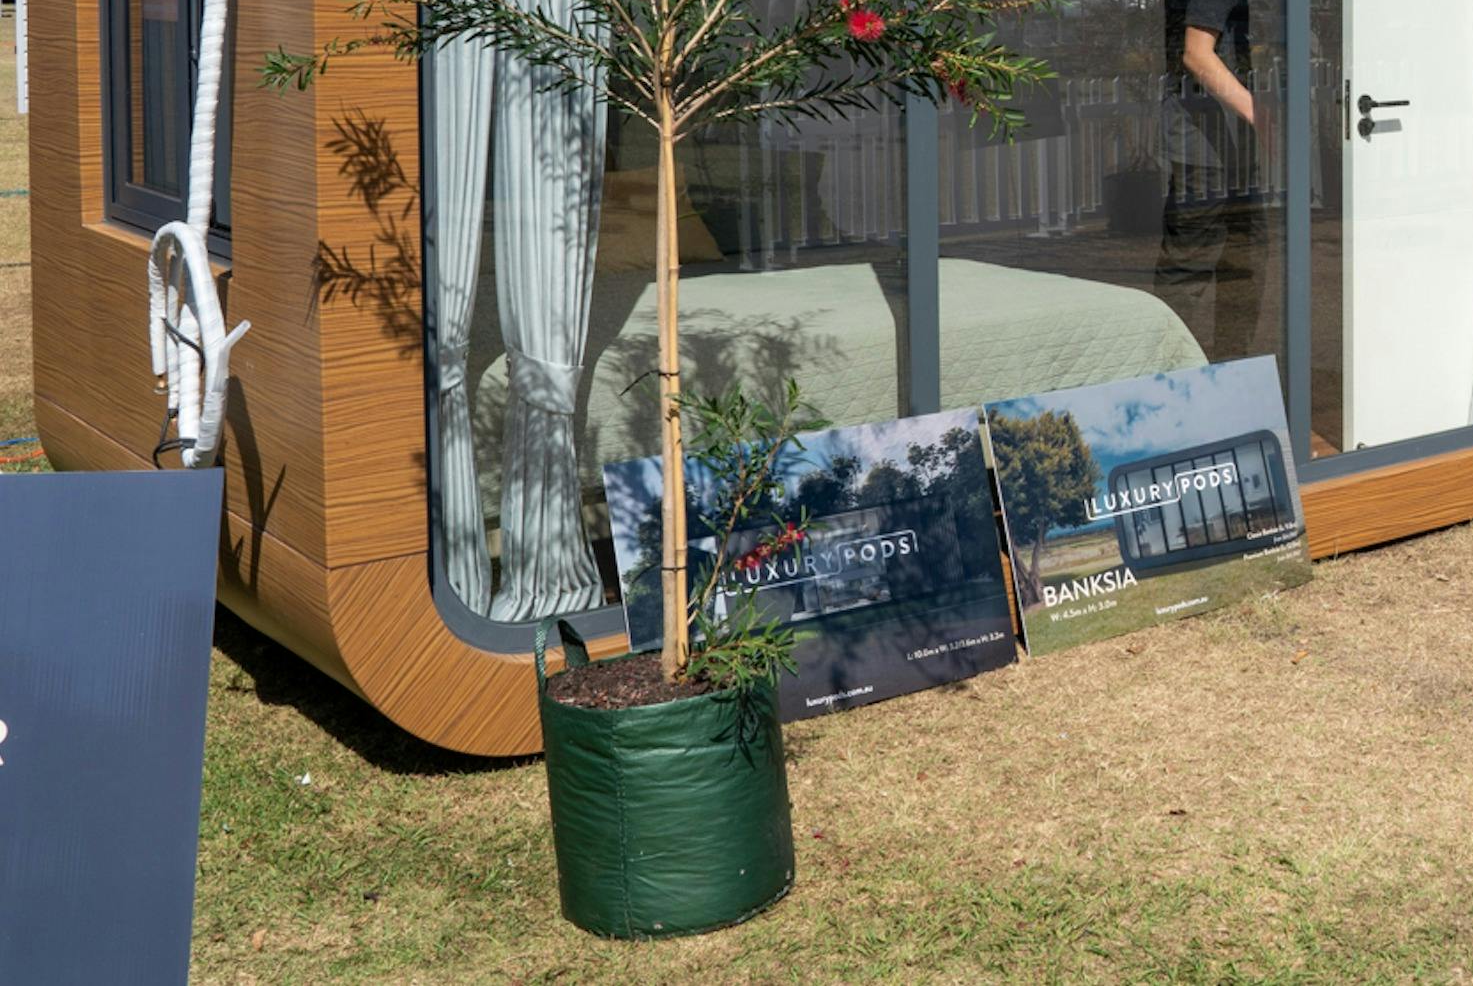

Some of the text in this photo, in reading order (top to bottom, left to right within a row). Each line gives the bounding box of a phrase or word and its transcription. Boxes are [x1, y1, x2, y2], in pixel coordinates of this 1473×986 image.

[1091, 468, 1233, 514] LUXURY PODS
[844, 536, 911, 565] PODS
[1043, 567, 1138, 607] BANKSIA
